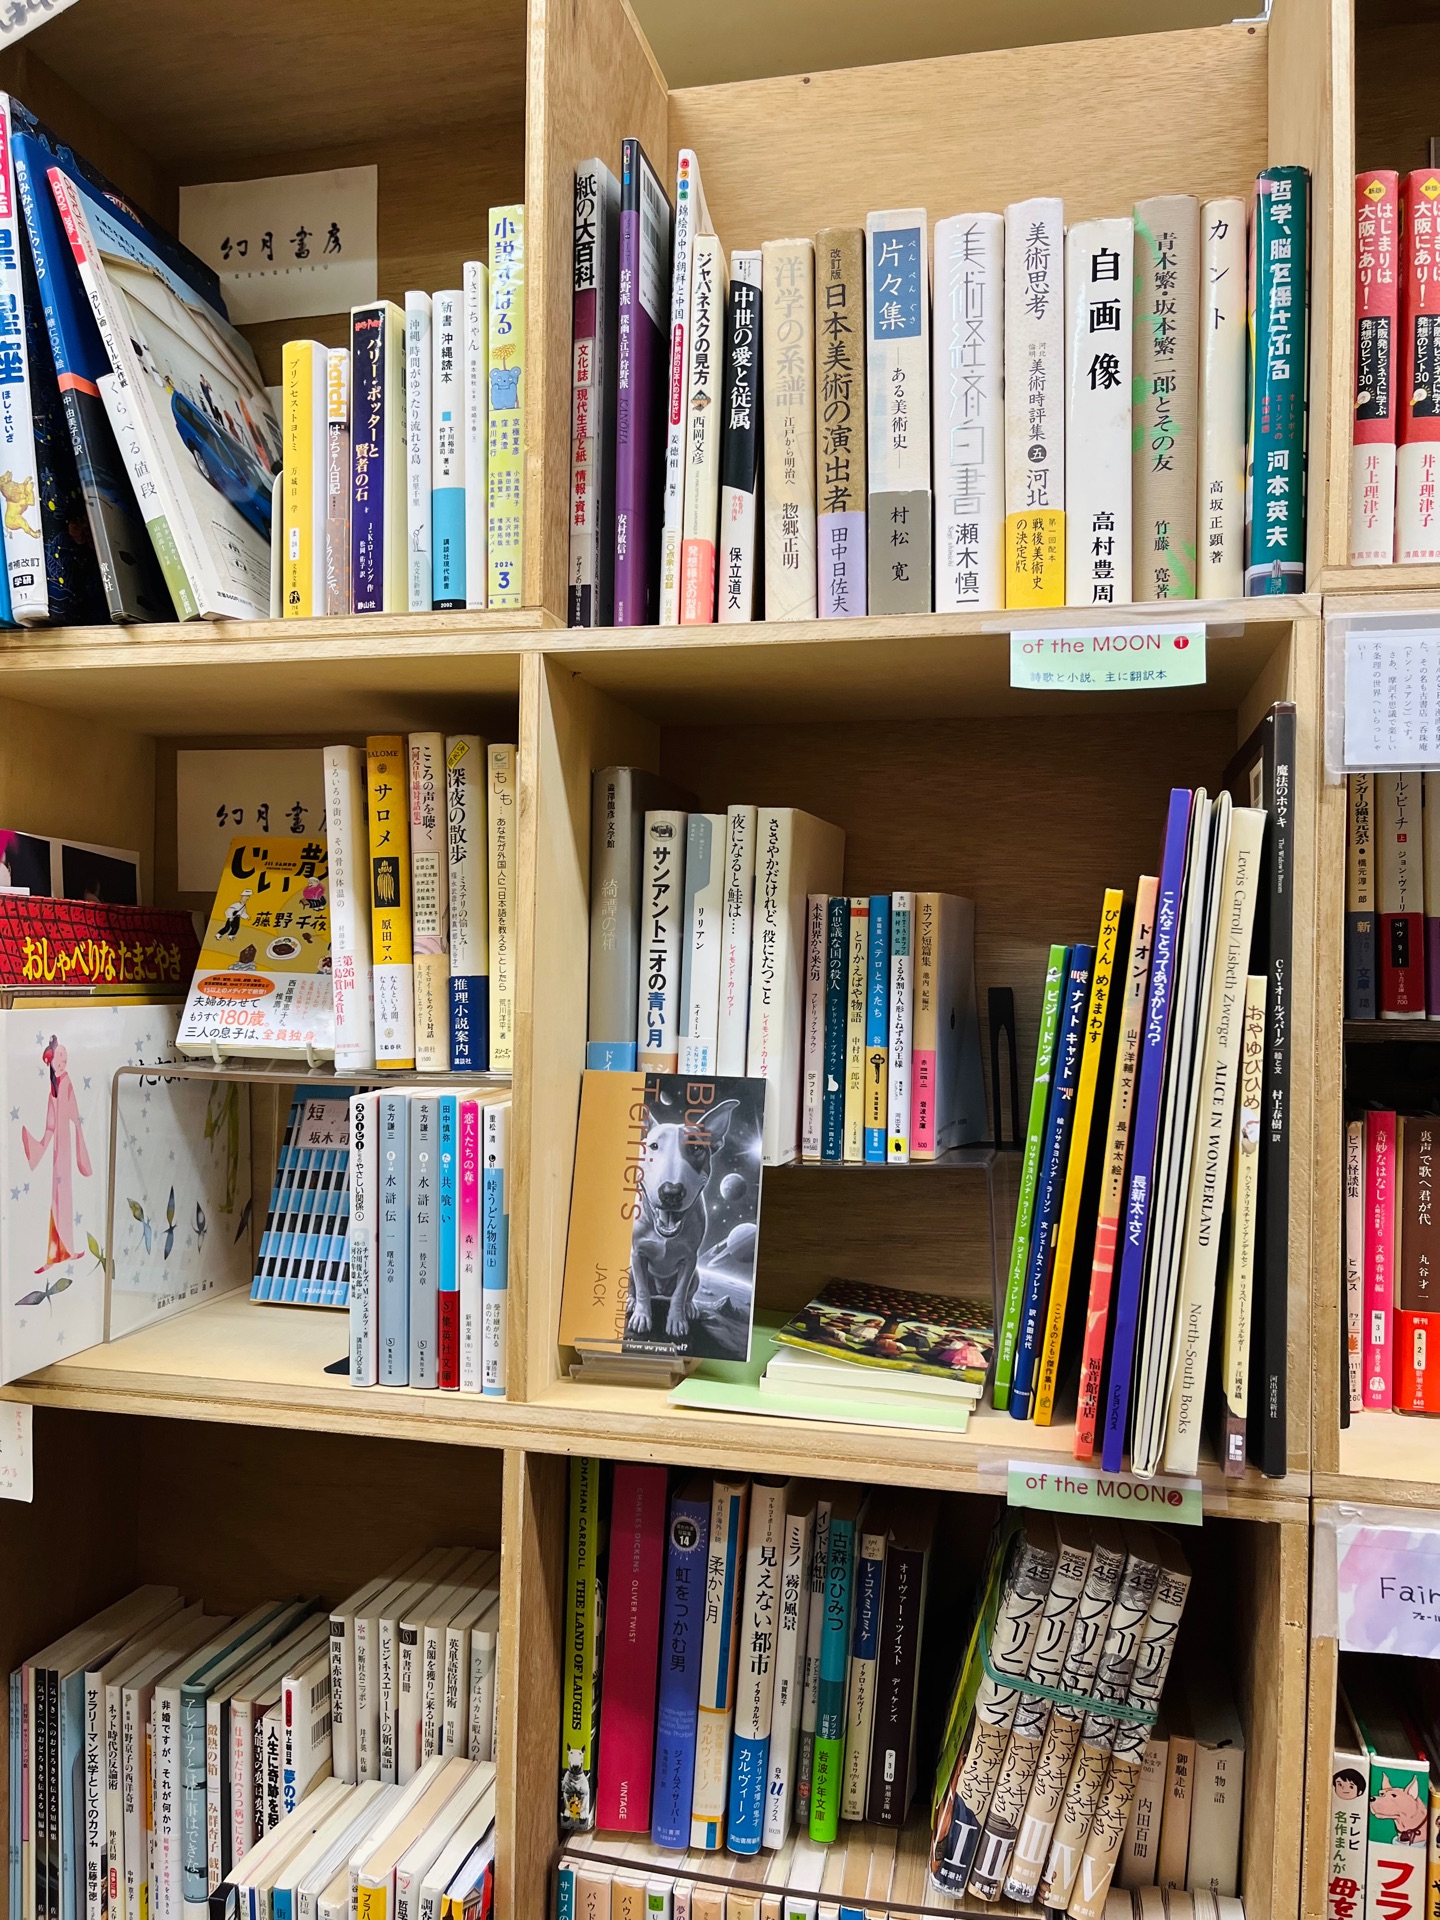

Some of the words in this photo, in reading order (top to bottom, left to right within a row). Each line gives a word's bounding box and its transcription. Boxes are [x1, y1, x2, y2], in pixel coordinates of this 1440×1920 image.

[575, 174, 597, 289] 紙の大百科
[674, 205, 689, 320] 錦絵の中の朝鮮と中国
[1358, 204, 1376, 310] 大阪にあり！
[1376, 202, 1393, 283] はじまりは
[1414, 201, 1432, 307] 大阪にあり！
[494, 217, 516, 335] 小説すばる
[620, 269, 631, 305] 狩野派
[830, 248, 842, 280] 改訂版
[877, 238, 908, 331] 片々集
[1024, 221, 1051, 320] 美術思考
[1208, 219, 1231, 330] カント
[409, 319, 421, 342] 沖縄
[441, 301, 453, 327] 新書
[468, 266, 480, 351] うさこちゃん
[694, 252, 712, 386] ジャパネスクの見方
[776, 256, 805, 408] 洋学の系譜
[1087, 246, 1122, 391] 自画像
[441, 333, 453, 383] 沖縄読本
[577, 344, 589, 382] 文化誌
[729, 286, 755, 430] 中世の愛と従属
[1150, 231, 1178, 473] 青木繁・坂本繁二郎とその友
[1358, 319, 1373, 385] 発想のヒント30
[1375, 318, 1388, 415] 大阪発ビジネスに学ぶ
[1414, 317, 1429, 384] 発想のヒント30
[2, 390, 14, 443] ほし・せいざ
[289, 359, 298, 451] プリンセス・トヨトミ
[366, 338, 382, 457] ハリー・ポッターと
[410, 345, 421, 464] 時間がゆったり流れる島
[575, 388, 588, 463] 現代生活と紙
[891, 368, 908, 450] ある美術史
[1028, 358, 1047, 441] 美術時評集
[110, 382, 158, 498] くらべる値段
[329, 424, 341, 495] はっちゃん日記
[692, 416, 705, 465] 西岡文彦
[784, 415, 796, 486] 江戸から明治へ
[355, 443, 369, 502] 賢者の石
[574, 470, 587, 526] 情報・資料
[1026, 468, 1050, 507] 河北
[1266, 450, 1290, 548] 河本英夫
[1363, 455, 1380, 528] 井上理津子
[1418, 454, 1436, 527] 井上理津子
[890, 506, 910, 547] 村松
[1015, 519, 1028, 573] の決定版
[1031, 517, 1045, 590] 戦後美術史
[1090, 511, 1115, 604] 高村豊周
[14, 576, 32, 587] 学研
[100, 563, 114, 592] 童心社
[413, 561, 421, 596] 光文社新書
[498, 571, 510, 589] 3
[728, 547, 742, 610] 保立道久
[829, 527, 850, 613] 田中日佐夫
[954, 522, 980, 603] 瀬木慎一
[1022, 639, 1043, 655] of
[1051, 638, 1085, 653] the
[1092, 634, 1161, 652] MOON
[373, 783, 394, 848] サロメ
[422, 746, 436, 841] こころの声を聴く
[447, 768, 467, 865] 深夜の散歩
[1276, 764, 1289, 828] 魔法のホウキ
[1235, 850, 1250, 887] Lewis
[1357, 858, 1368, 904] 橋元淳一郎
[252, 911, 327, 932] 藤野千夜
[496, 818, 507, 991] あなたが外国人に「日本語を教える」としたら
[695, 907, 705, 950] リリアン
[761, 818, 780, 1005] ささやかだけれど、役にたつこと
[921, 903, 933, 967] ホフマン短篇集
[22, 936, 182, 982] おしゃべりなたまごやき
[381, 919, 393, 962] 原田マハ
[646, 845, 671, 1048] サンアントニオの青い月
[810, 902, 823, 982] 未来世界から来た男
[829, 906, 843, 990] 不思議な国の殺人
[1099, 909, 1120, 965] ぴかくん
[193, 996, 260, 1008] 夫婦あわせて
[728, 943, 737, 1016] レイモンド・カーヴァー
[850, 931, 865, 1023] とりかえばや物語
[1045, 989, 1060, 1028] ビジー
[1069, 989, 1085, 1027] ナイト
[1088, 974, 1109, 1043] めをまわす
[190, 1009, 270, 1027] もうすぐ180歳。
[453, 978, 470, 1056] 推理小説案内
[499, 999, 507, 1029] 荒川洋平
[810, 993, 818, 1053] フレドリック・ブラウン
[894, 958, 906, 1068] くるみ割り人形とねずみの王様
[1216, 994, 1236, 1048] Zwerger
[1038, 1031, 1054, 1067] ドッグ
[1063, 1032, 1078, 1079] キャット
[1243, 1005, 1265, 1109] おやゆびひめ
[683, 1081, 716, 1147] Bull
[918, 1100, 927, 1129] 岩波文庫
[1213, 1060, 1228, 1106] ALICE
[1271, 1089, 1284, 1129] 村上春樹
[442, 1105, 451, 1142] 田中慎弥
[463, 1112, 474, 1182] 恋人たちの森
[620, 1079, 661, 1222] Terriers
[1211, 1112, 1222, 1130] IN
[1198, 1135, 1220, 1247] WONDERLAND
[1375, 1130, 1388, 1201] 奇妙なはなし
[1418, 1130, 1433, 1226] 裏声で歌へ君が代
[385, 1174, 397, 1222] 水滸伝
[418, 1176, 430, 1224] 水滸伝
[441, 1176, 452, 1224] 共喰い
[386, 1250, 395, 1283] 曙光の章
[592, 1262, 609, 1308] JACK
[1374, 1244, 1385, 1293] 文藝春秋編
[1418, 1254, 1431, 1298] 丸谷才一
[1024, 1319, 1035, 1349] 角田光代
[1082, 1357, 1102, 1419] 福音館書店
[1178, 1394, 1192, 1434] Books
[1025, 1475, 1048, 1491] of
[1053, 1476, 1089, 1496] the
[1096, 1480, 1166, 1505] MOON
[578, 1517, 588, 1570] CARROLL
[679, 1534, 691, 1546] 14
[789, 1527, 801, 1568] ミラノ
[1059, 1562, 1084, 1577] 45
[576, 1578, 586, 1609] THE
[630, 1579, 639, 1612] OLIVER
[705, 1555, 724, 1624] 柔かい月
[749, 1544, 778, 1677] 見えない都市
[783, 1573, 800, 1631] 霧の風景
[828, 1532, 849, 1632] 古森のひみつ
[860, 1562, 876, 1642] レ・コスミコミケ
[894, 1563, 909, 1665] オリヴァー・ツイスト
[1158, 1588, 1183, 1603] 45
[574, 1610, 585, 1649] LAND
[628, 1615, 637, 1643] TWIST
[669, 1566, 692, 1673] 虹をつかむ男
[331, 1641, 343, 1723] 関西赤貧古本道
[402, 1649, 412, 1693] 新書百冊
[447, 1638, 459, 1709] 英単語倍増術
[573, 1654, 584, 1674] OF
[381, 1638, 392, 1769] ビジネスエリートの新論語
[571, 1675, 583, 1731] LAUGHS
[889, 1678, 901, 1723] ディケンズ
[107, 1704, 118, 1790] ネット時代の反論術
[124, 1722, 134, 1813] 中野京子の西洋奇譚
[207, 1723, 218, 1776] 微熱の箱
[285, 1729, 293, 1765] 村上朝日堂
[974, 1731, 1008, 1816] ヤマザキマリ
[1046, 1725, 1080, 1813] ヤマザキマリ
[617, 1780, 629, 1820] VINTAGE
[670, 1749, 683, 1824] ジェイムズ・サーバー
[735, 1748, 752, 1824] カルヴィーノ
[814, 1751, 829, 1822] 岩波少年文庫
[1008, 1742, 1040, 1828] ヤマザキマリ
[1213, 1759, 1227, 1804] 百物語
[1332, 1811, 1348, 1874] 名作まんが
